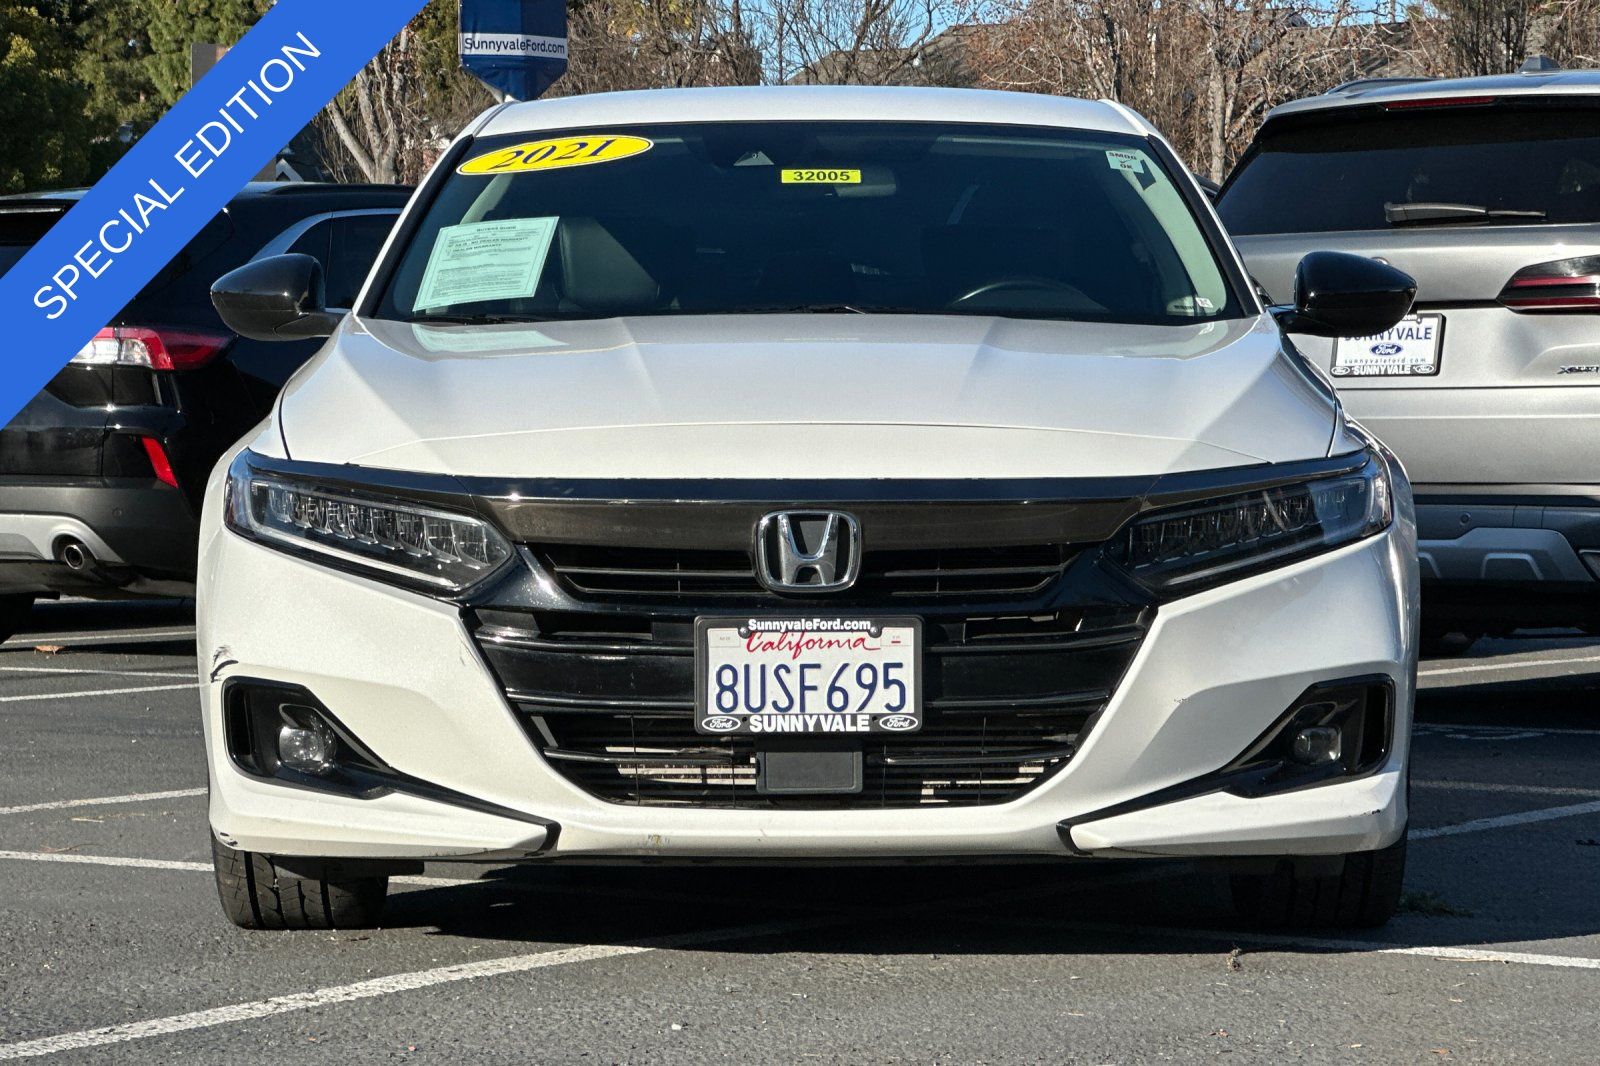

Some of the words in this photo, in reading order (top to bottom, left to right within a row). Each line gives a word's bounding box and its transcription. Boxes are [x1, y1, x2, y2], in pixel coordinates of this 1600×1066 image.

[464, 37, 566, 55] SunnyvaleFord.com
[488, 139, 617, 170] 2021
[793, 170, 850, 182] 32005
[1344, 327, 1432, 340] NYVALE
[1353, 365, 1411, 375] SUNNYVALE
[748, 618, 871, 632] SunnyvaleFord.com
[746, 630, 880, 660] California
[715, 662, 906, 713] 8USF695
[749, 714, 870, 732] SUNNYVALE
